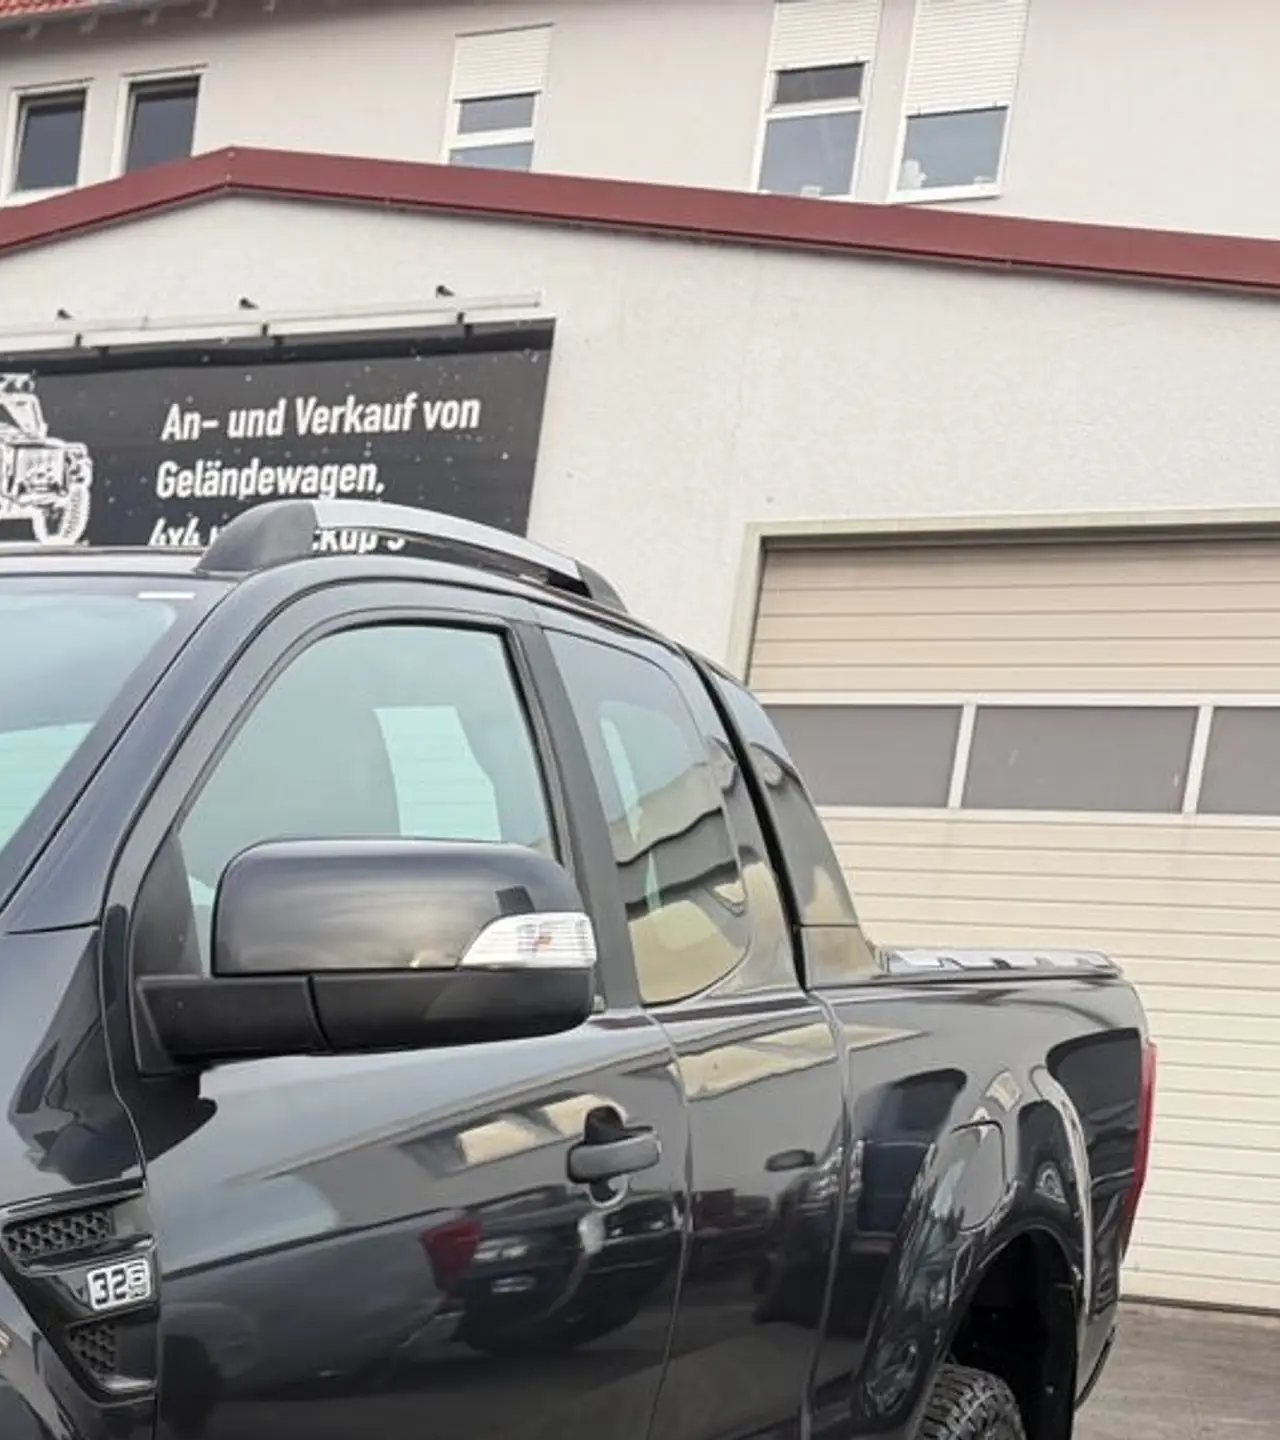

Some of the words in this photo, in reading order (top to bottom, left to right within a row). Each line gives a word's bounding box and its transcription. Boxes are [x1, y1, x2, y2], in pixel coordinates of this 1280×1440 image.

[160, 401, 219, 441] An-
[227, 398, 287, 440] und
[294, 391, 417, 437] Verkauf
[422, 398, 481, 431] von
[155, 457, 385, 501] Geländewagen,
[148, 517, 201, 547] 4x4
